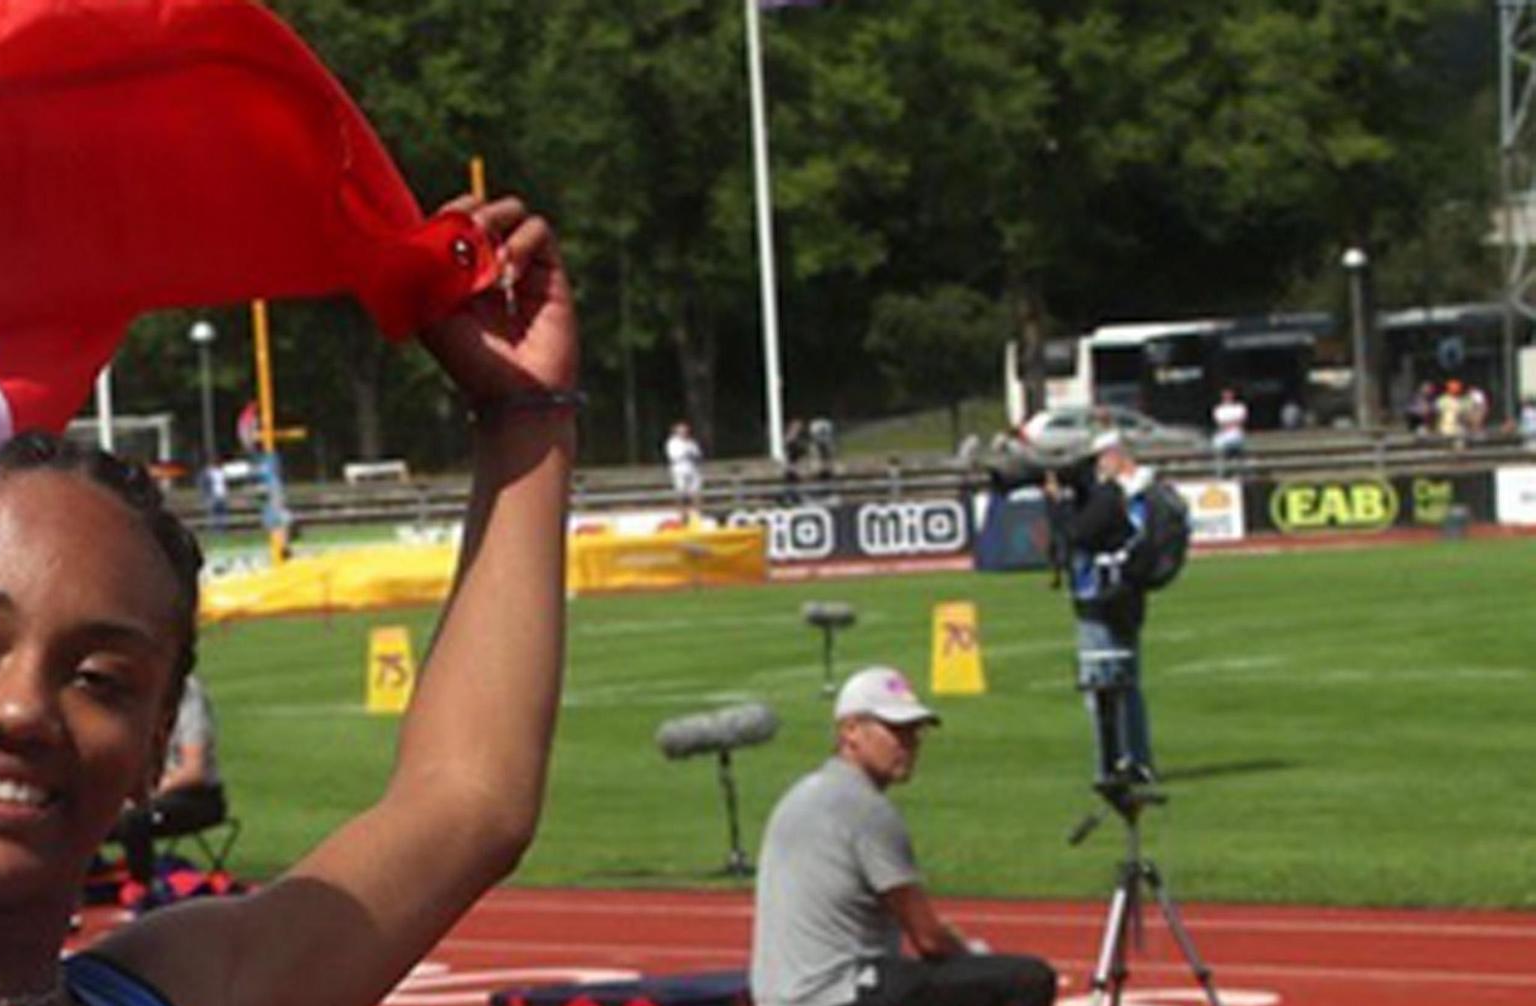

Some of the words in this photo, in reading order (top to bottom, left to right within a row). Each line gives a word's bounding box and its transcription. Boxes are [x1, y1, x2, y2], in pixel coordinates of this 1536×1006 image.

[1285, 484, 1387, 526] EAB
[941, 623, 979, 657] 70
[374, 652, 410, 689] 75
